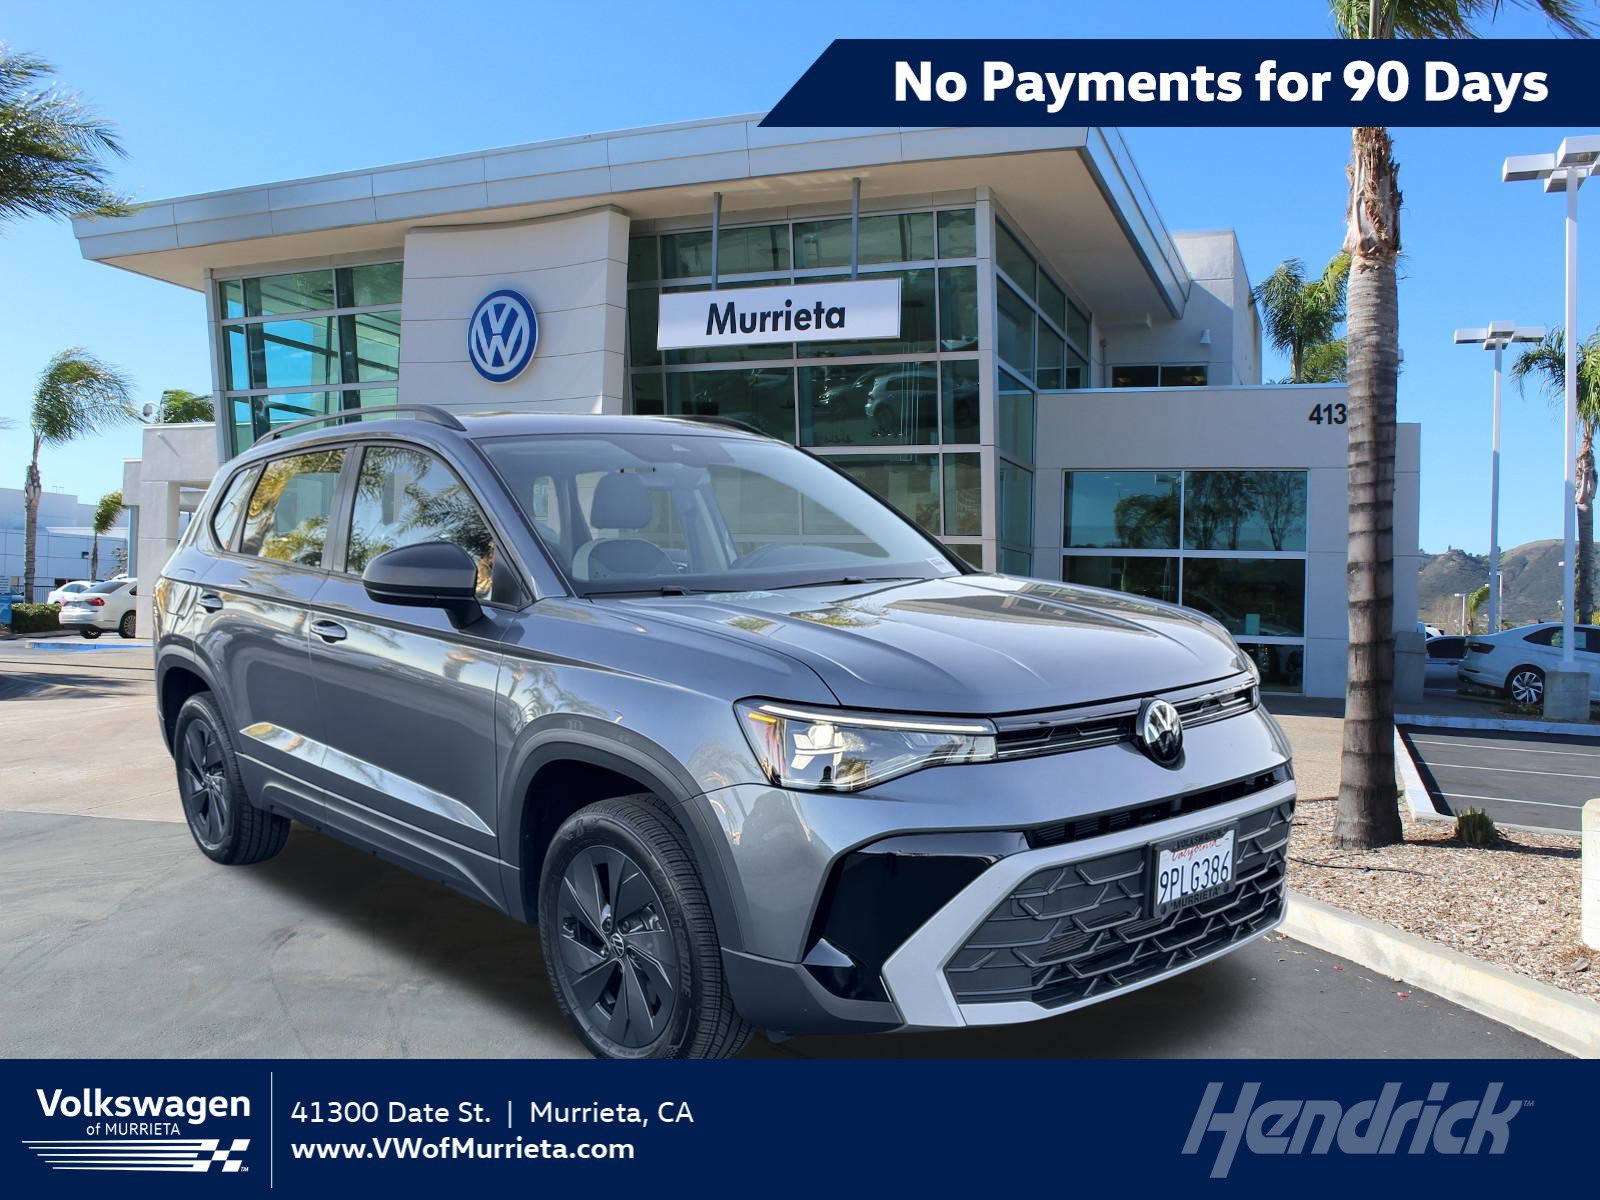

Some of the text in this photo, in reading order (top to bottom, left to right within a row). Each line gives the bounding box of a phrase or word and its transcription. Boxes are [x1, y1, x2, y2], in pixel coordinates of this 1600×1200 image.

[705, 299, 846, 335] Murrieta
[1308, 403, 1348, 425] 413
[1159, 850, 1231, 905] 9PLG386
